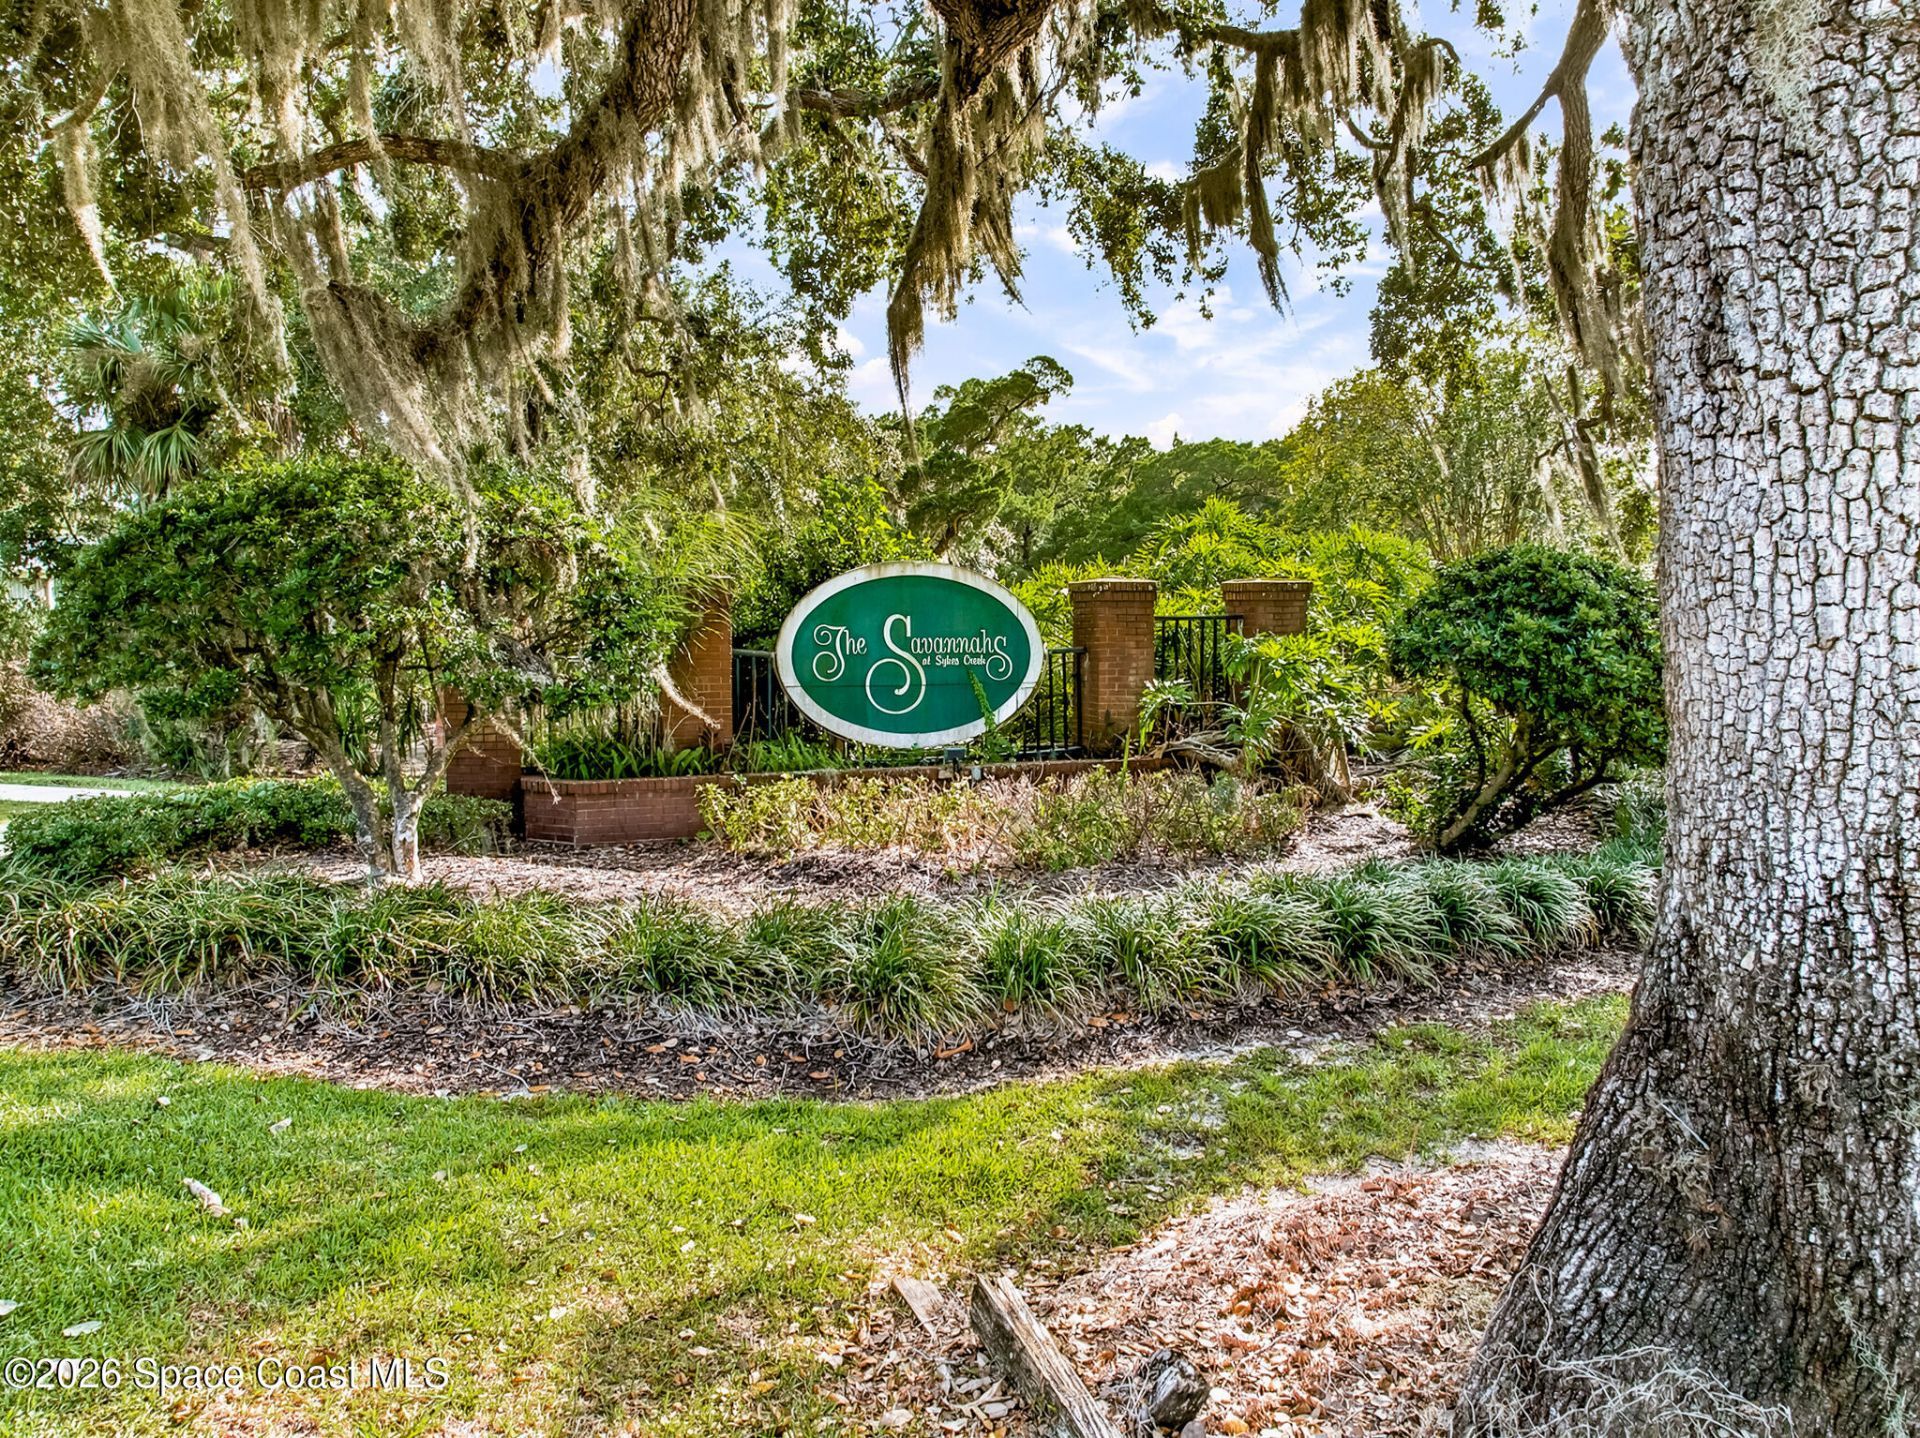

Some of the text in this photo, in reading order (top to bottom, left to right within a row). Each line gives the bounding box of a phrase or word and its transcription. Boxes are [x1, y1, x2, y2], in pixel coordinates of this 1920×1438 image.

[813, 613, 1013, 715] The Savannahs
[922, 655, 986, 668] at Sykes Creek
